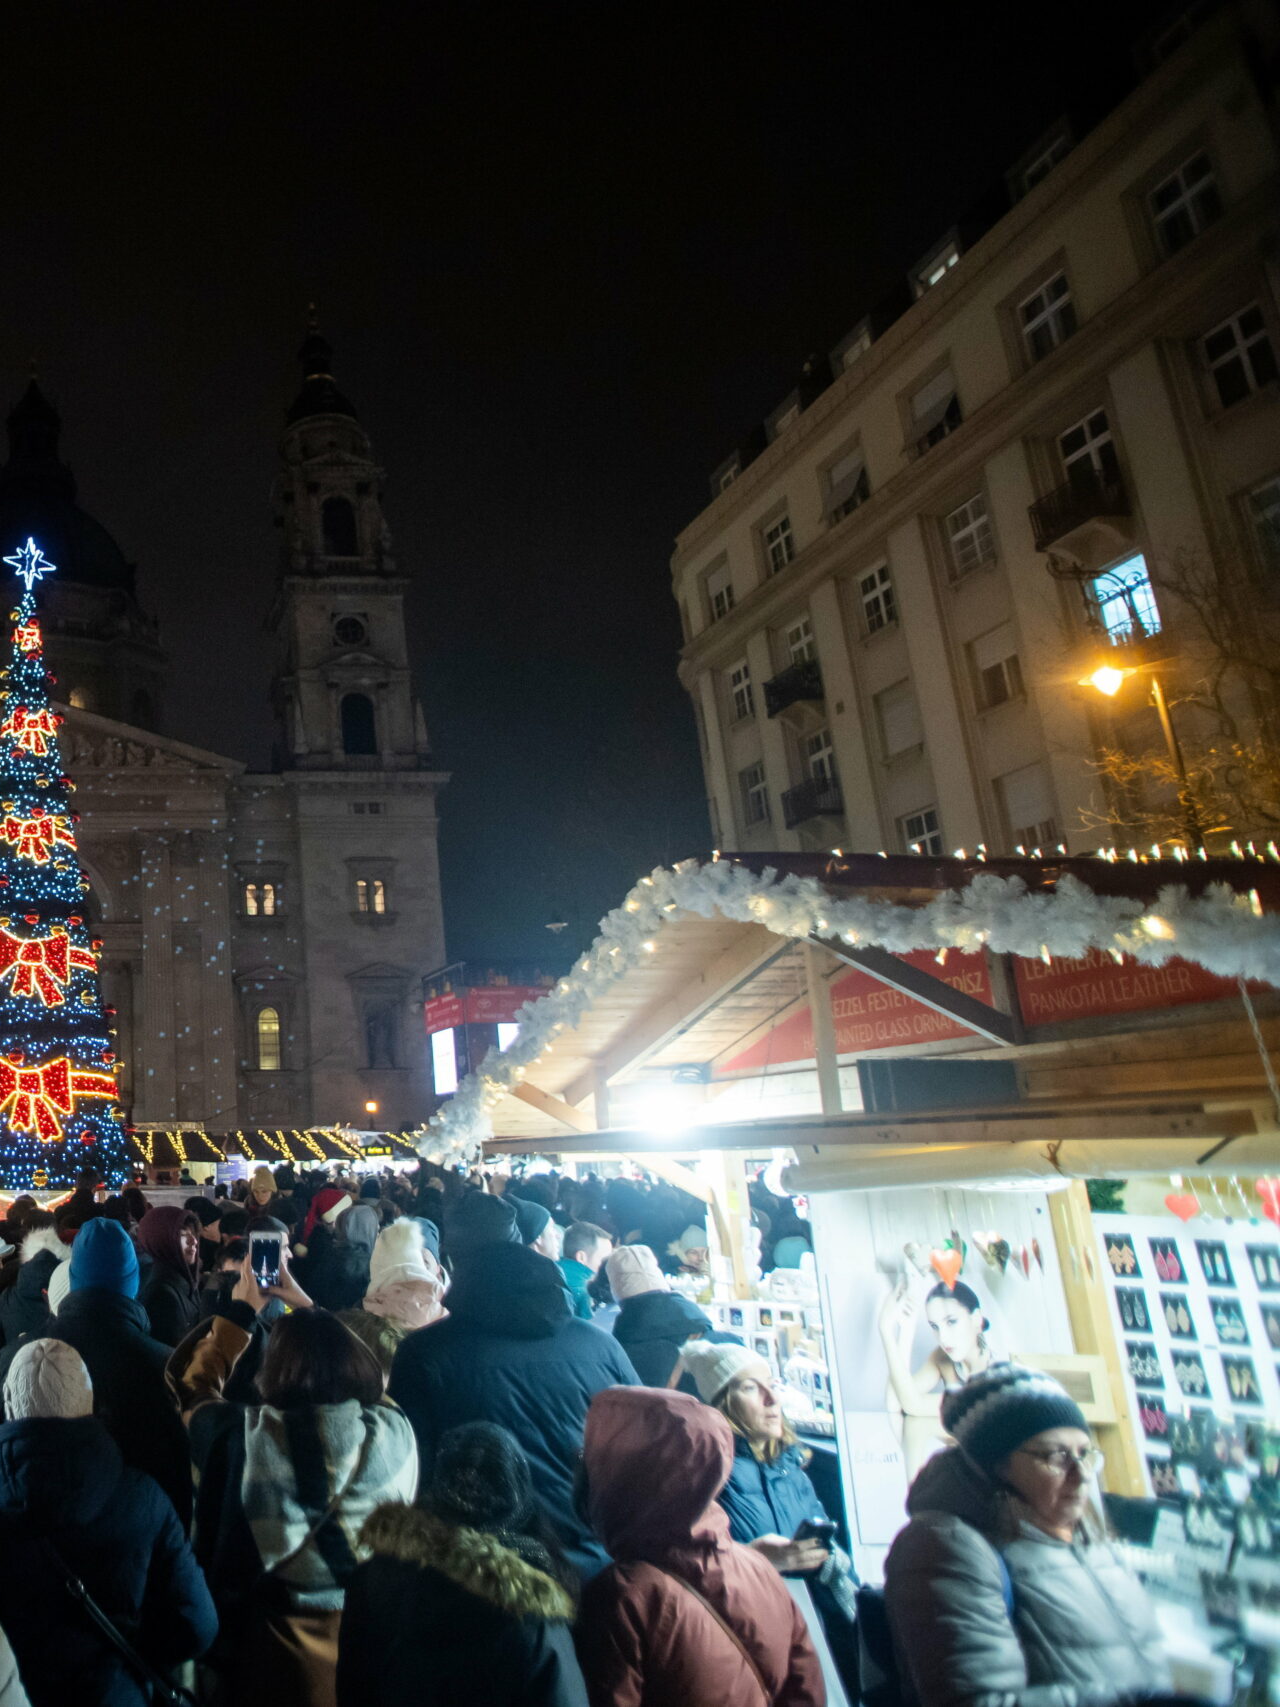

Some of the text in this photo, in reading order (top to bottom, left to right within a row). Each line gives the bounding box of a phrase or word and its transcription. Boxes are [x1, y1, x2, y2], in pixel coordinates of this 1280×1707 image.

[1029, 967, 1195, 1015] PANKOTAI LEATHER
[832, 996, 867, 1018] ÉZZEL
[875, 1016, 912, 1040] GLASS
